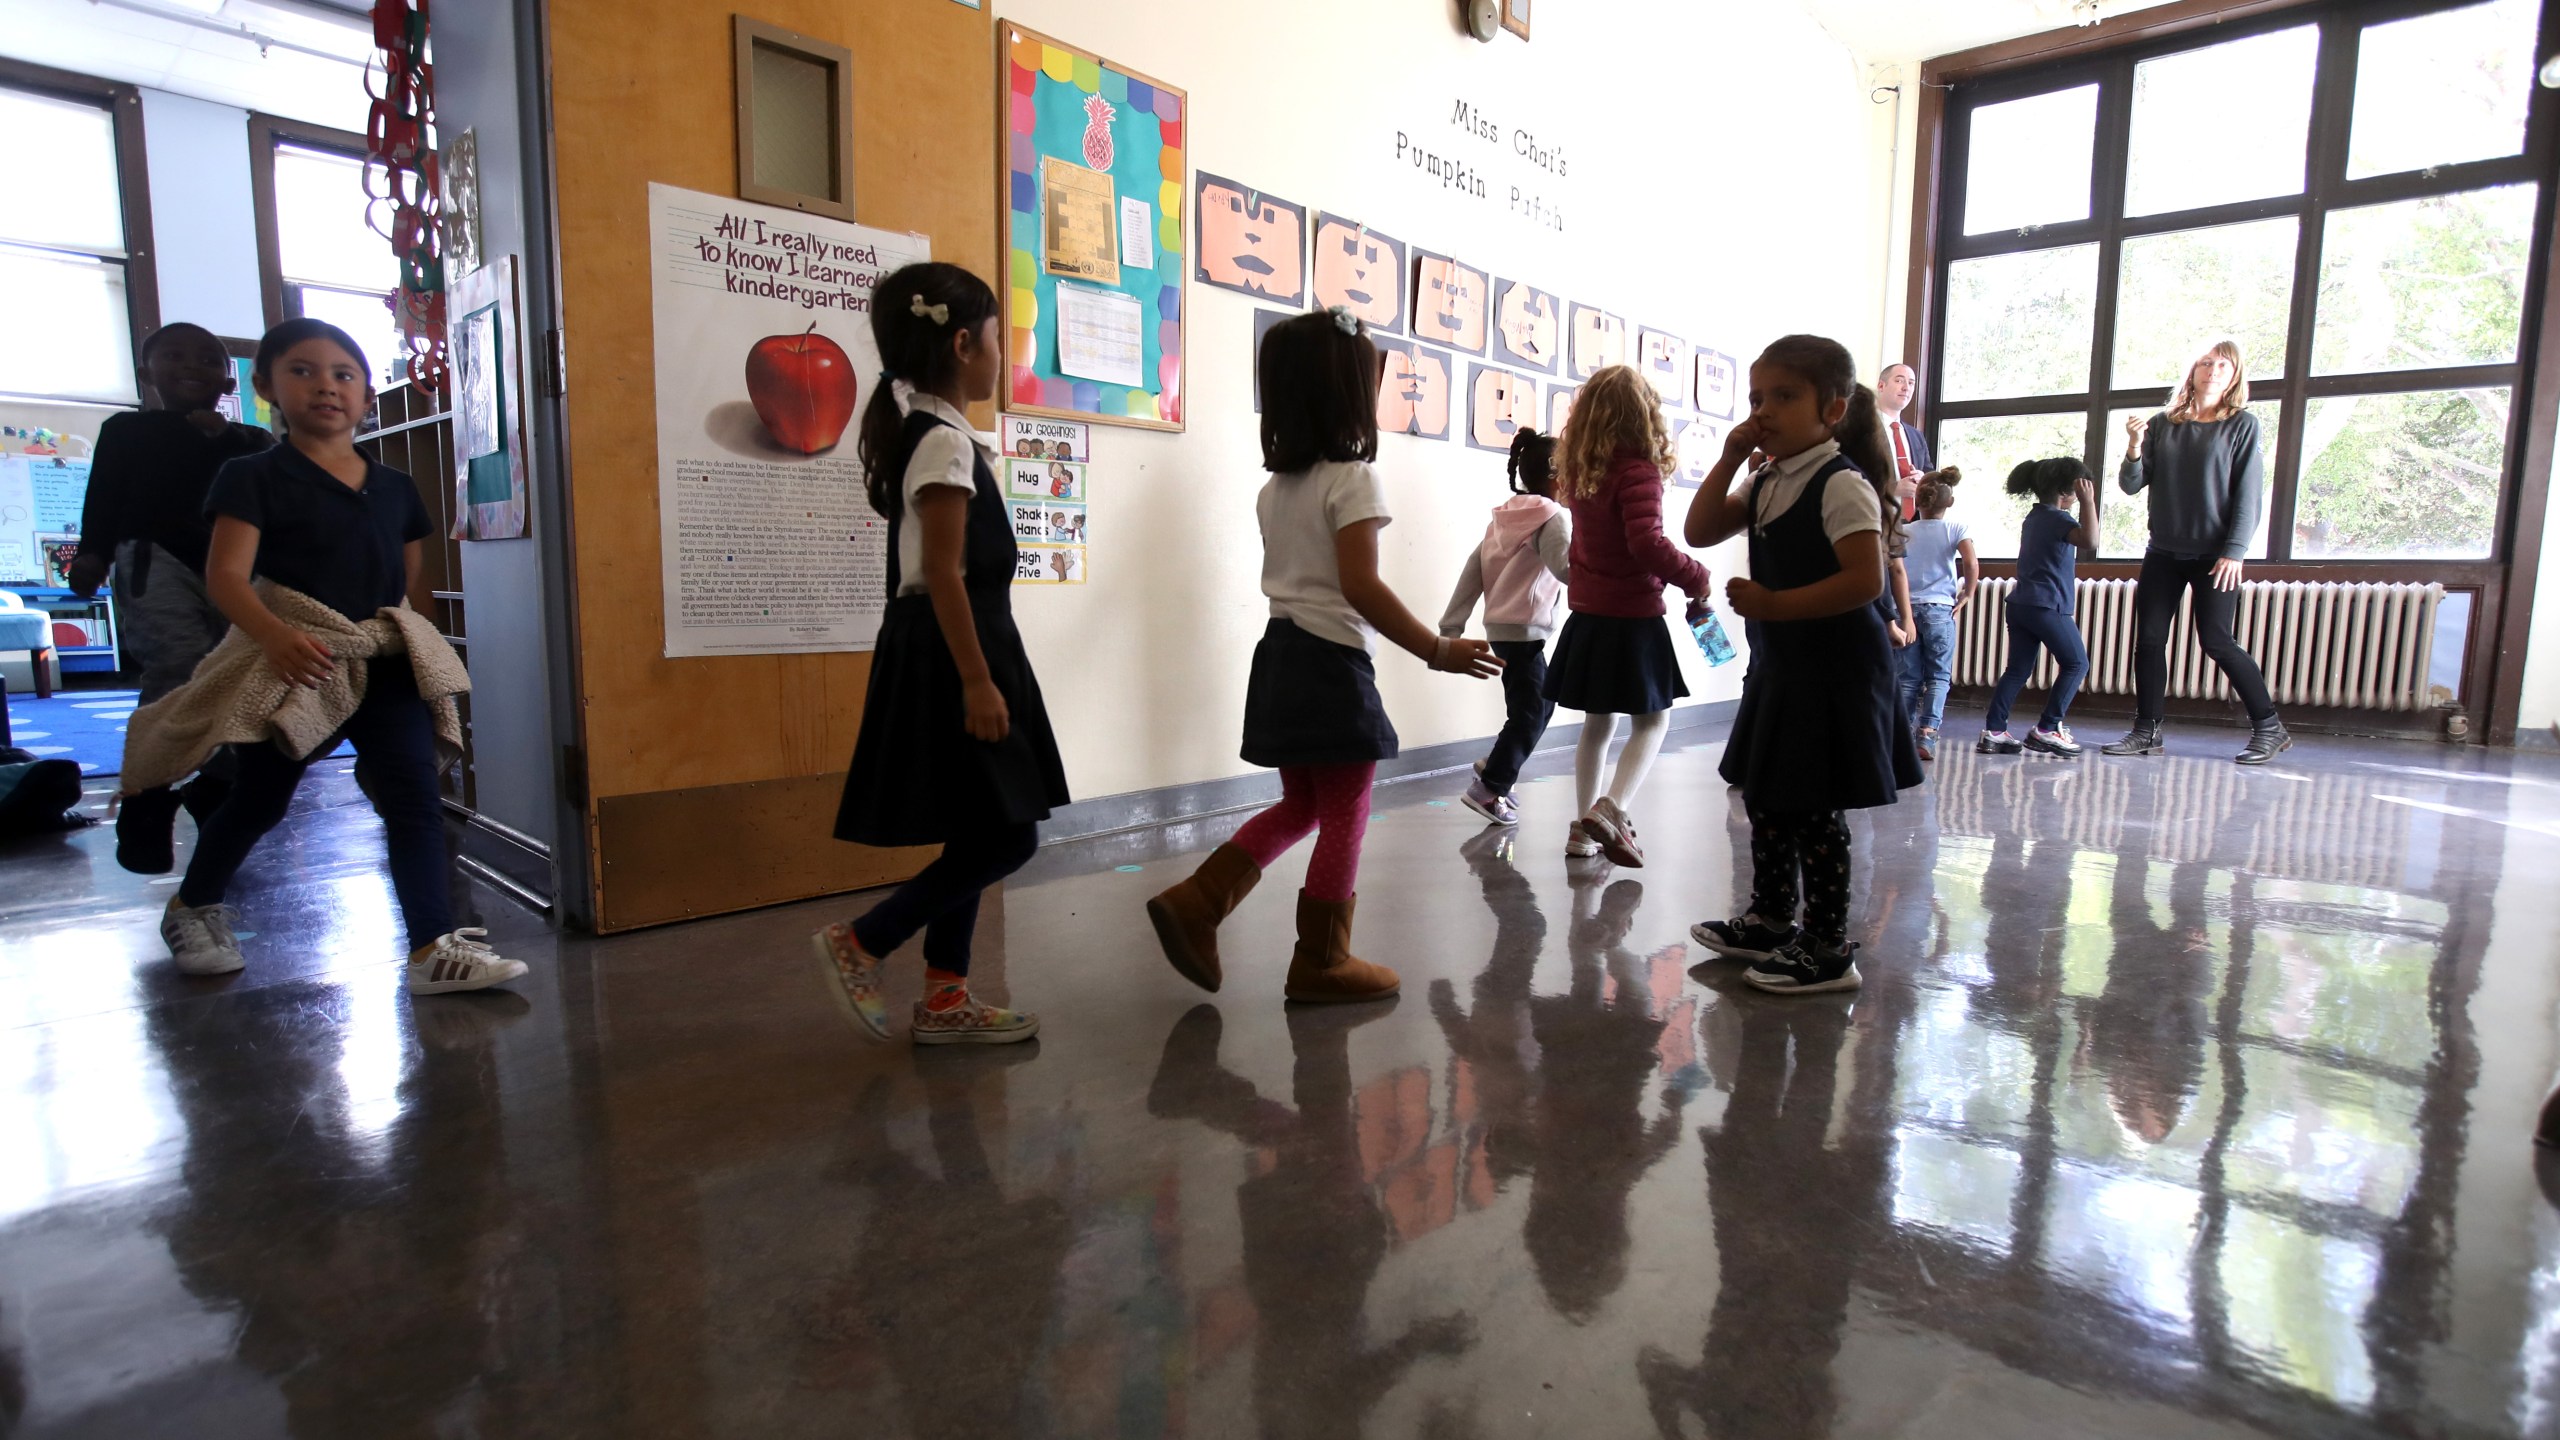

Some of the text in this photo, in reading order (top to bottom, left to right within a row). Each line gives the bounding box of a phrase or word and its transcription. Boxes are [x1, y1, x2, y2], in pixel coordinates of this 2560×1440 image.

[1451, 99, 1566, 176] Miss Chai's
[1397, 131, 1485, 198] Pumpkin
[714, 213, 877, 267] All I really need
[694, 236, 879, 290] to know I learned
[725, 269, 869, 313] kindergarten
[1016, 422, 1033, 434] OUR
[1018, 471, 1039, 486] Hug
[1018, 551, 1040, 565] High
[1018, 566, 1040, 578] Five
